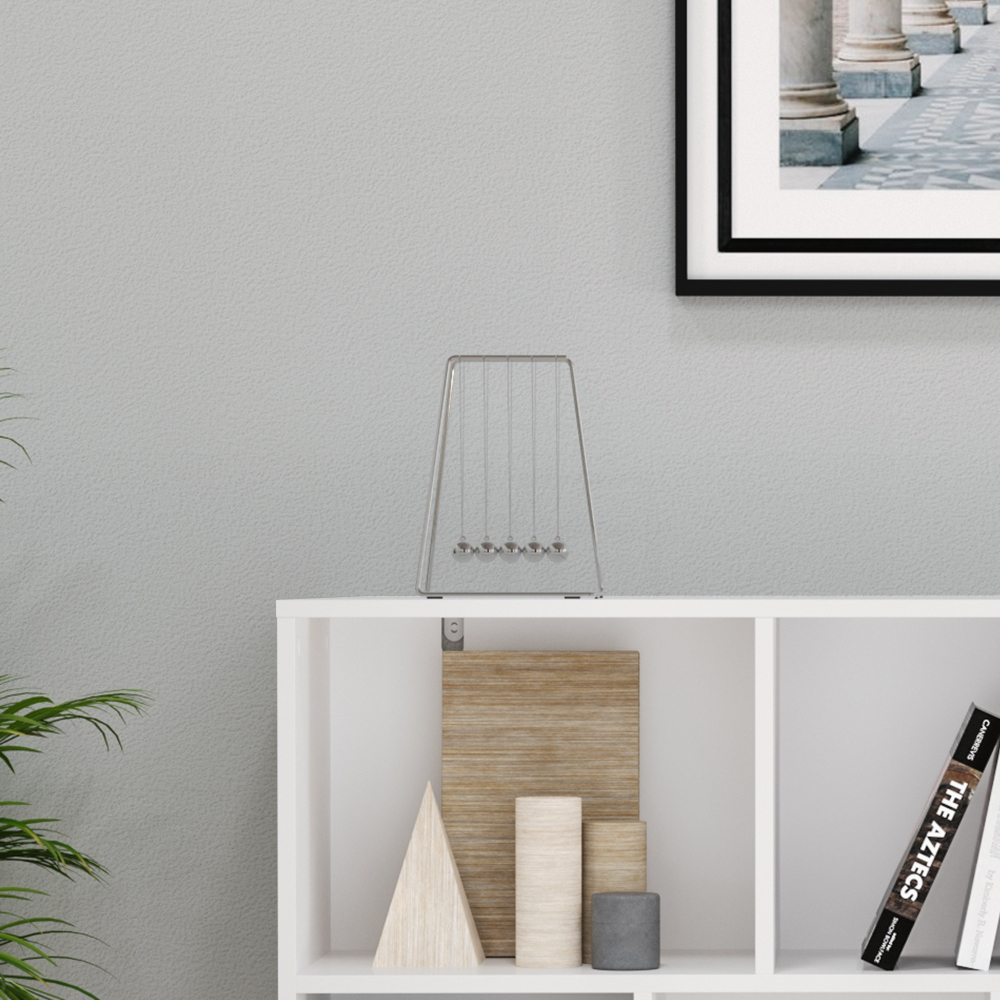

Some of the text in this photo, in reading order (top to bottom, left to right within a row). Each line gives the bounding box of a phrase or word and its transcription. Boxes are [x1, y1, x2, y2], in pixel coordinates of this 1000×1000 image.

[900, 780, 968, 902] THE AZTECS
[977, 881, 993, 919] Kimberly
